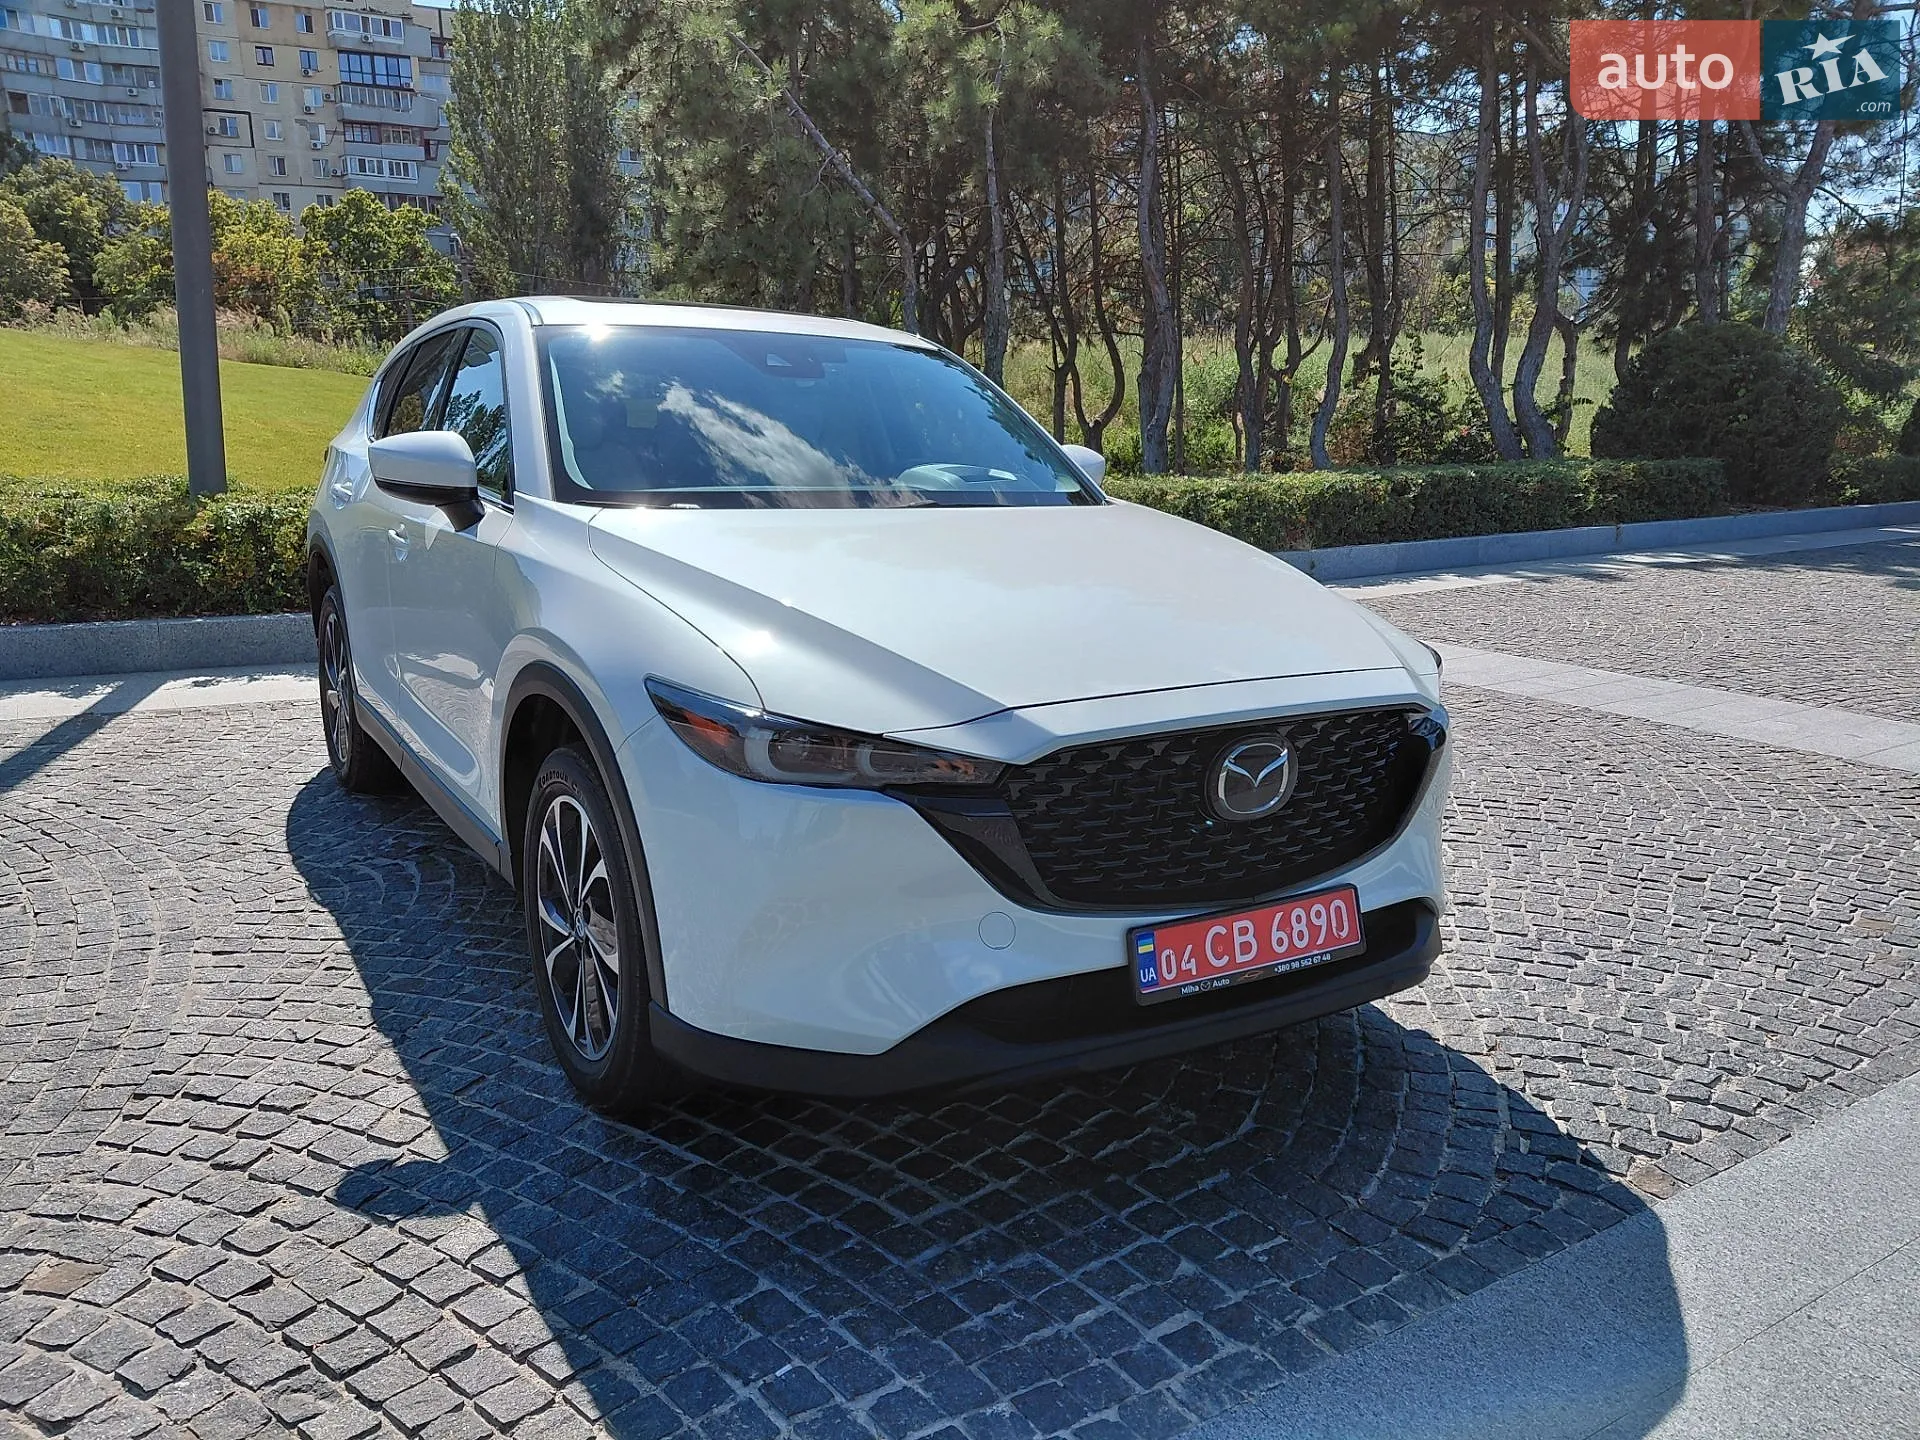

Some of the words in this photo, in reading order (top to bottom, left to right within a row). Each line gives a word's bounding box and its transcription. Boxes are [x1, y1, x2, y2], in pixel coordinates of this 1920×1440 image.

[1160, 944, 1197, 981] 04
[1205, 919, 1258, 968] CB
[1270, 899, 1349, 954] 6890
[1140, 967, 1157, 983] UA
[1181, 984, 1200, 995] Miha
[1212, 978, 1230, 987] Auto
